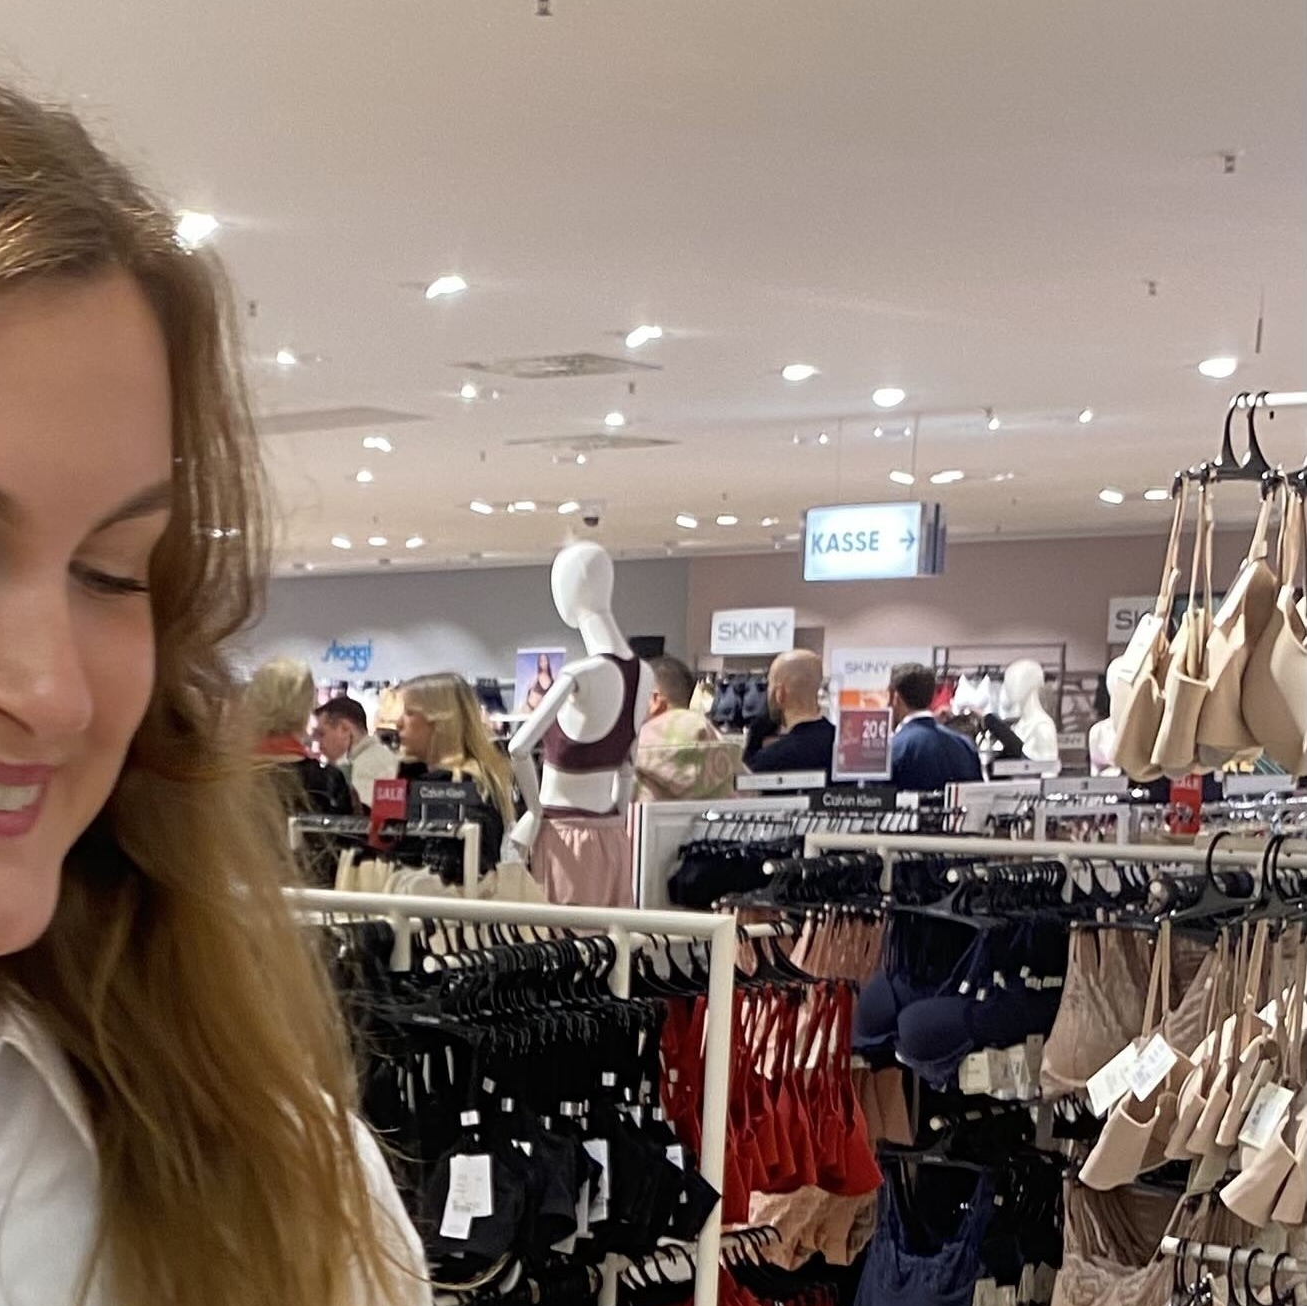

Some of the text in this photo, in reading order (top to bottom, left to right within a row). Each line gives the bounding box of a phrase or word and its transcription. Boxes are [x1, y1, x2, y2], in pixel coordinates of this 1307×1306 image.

[812, 531, 879, 554] KASSE
[718, 621, 787, 641] SKINY
[844, 661, 889, 675] SKINY
[822, 793, 881, 807] Calvin Klein
